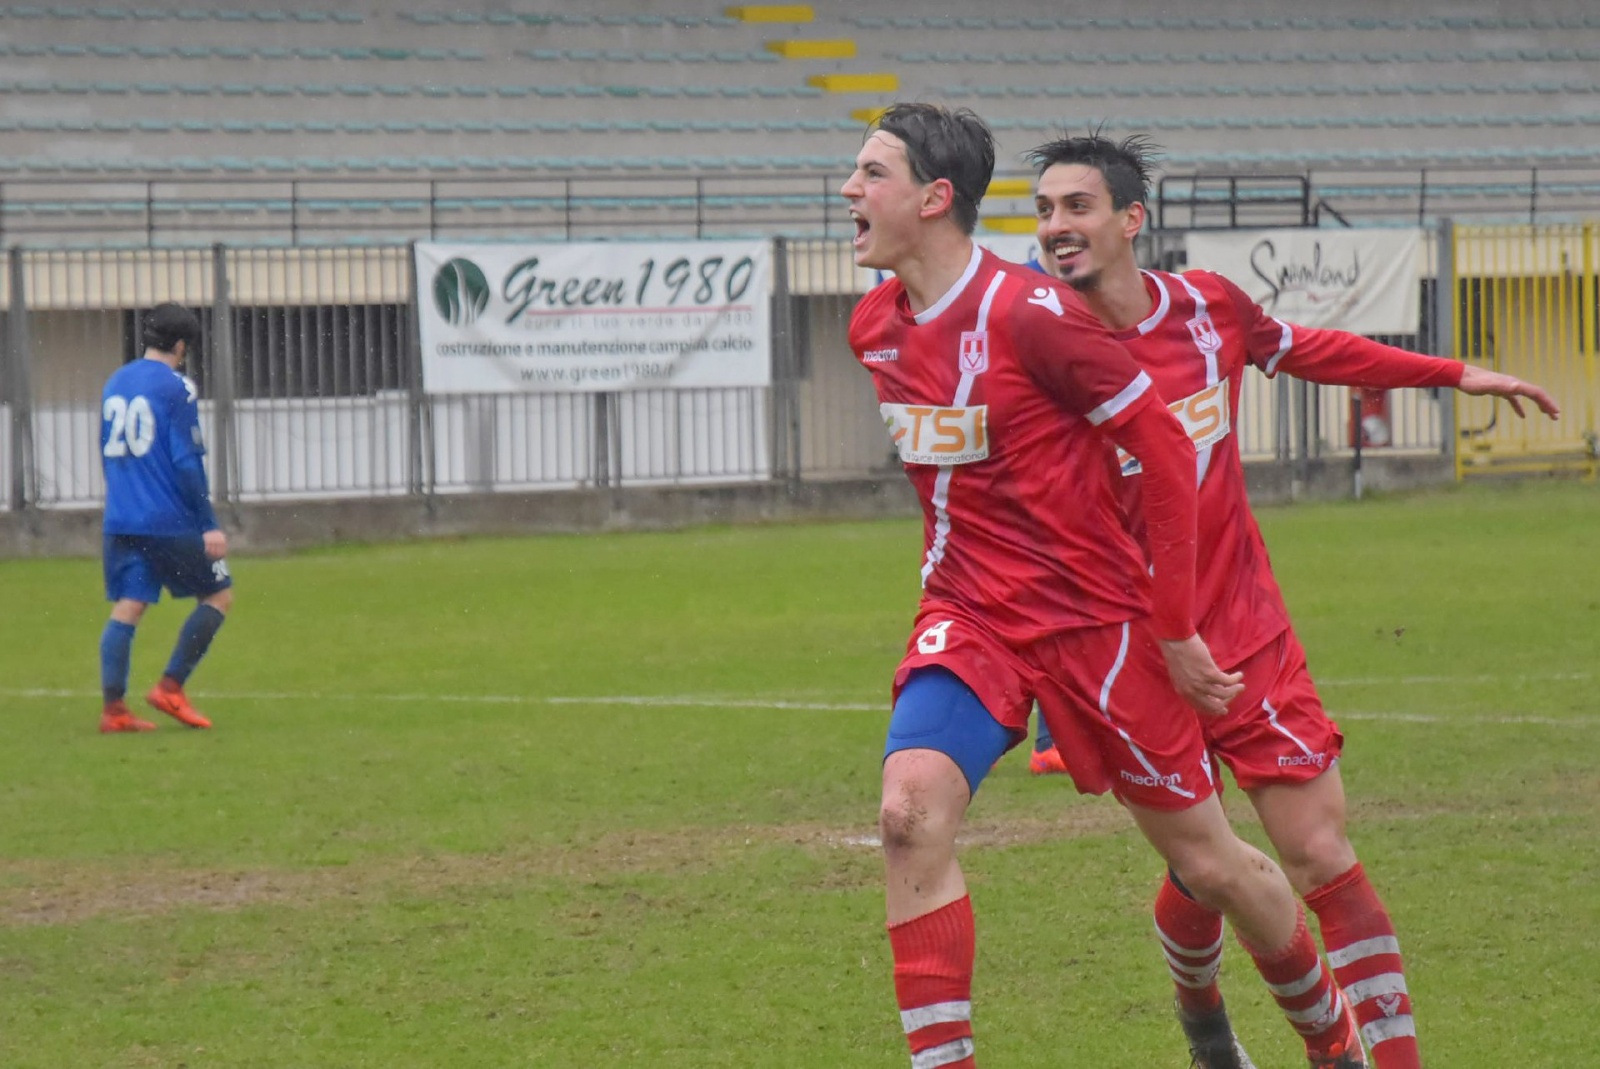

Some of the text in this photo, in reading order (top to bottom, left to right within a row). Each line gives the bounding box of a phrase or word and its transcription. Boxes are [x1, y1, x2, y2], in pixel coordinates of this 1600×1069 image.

[436, 338, 522, 357] costruzione
[525, 344, 534, 356] e
[537, 336, 647, 356] manutenzione
[711, 331, 753, 350] calcio
[863, 349, 898, 362] macron
[103, 396, 155, 458] 20
[1277, 752, 1326, 768] macron
[1120, 770, 1182, 788] macron
